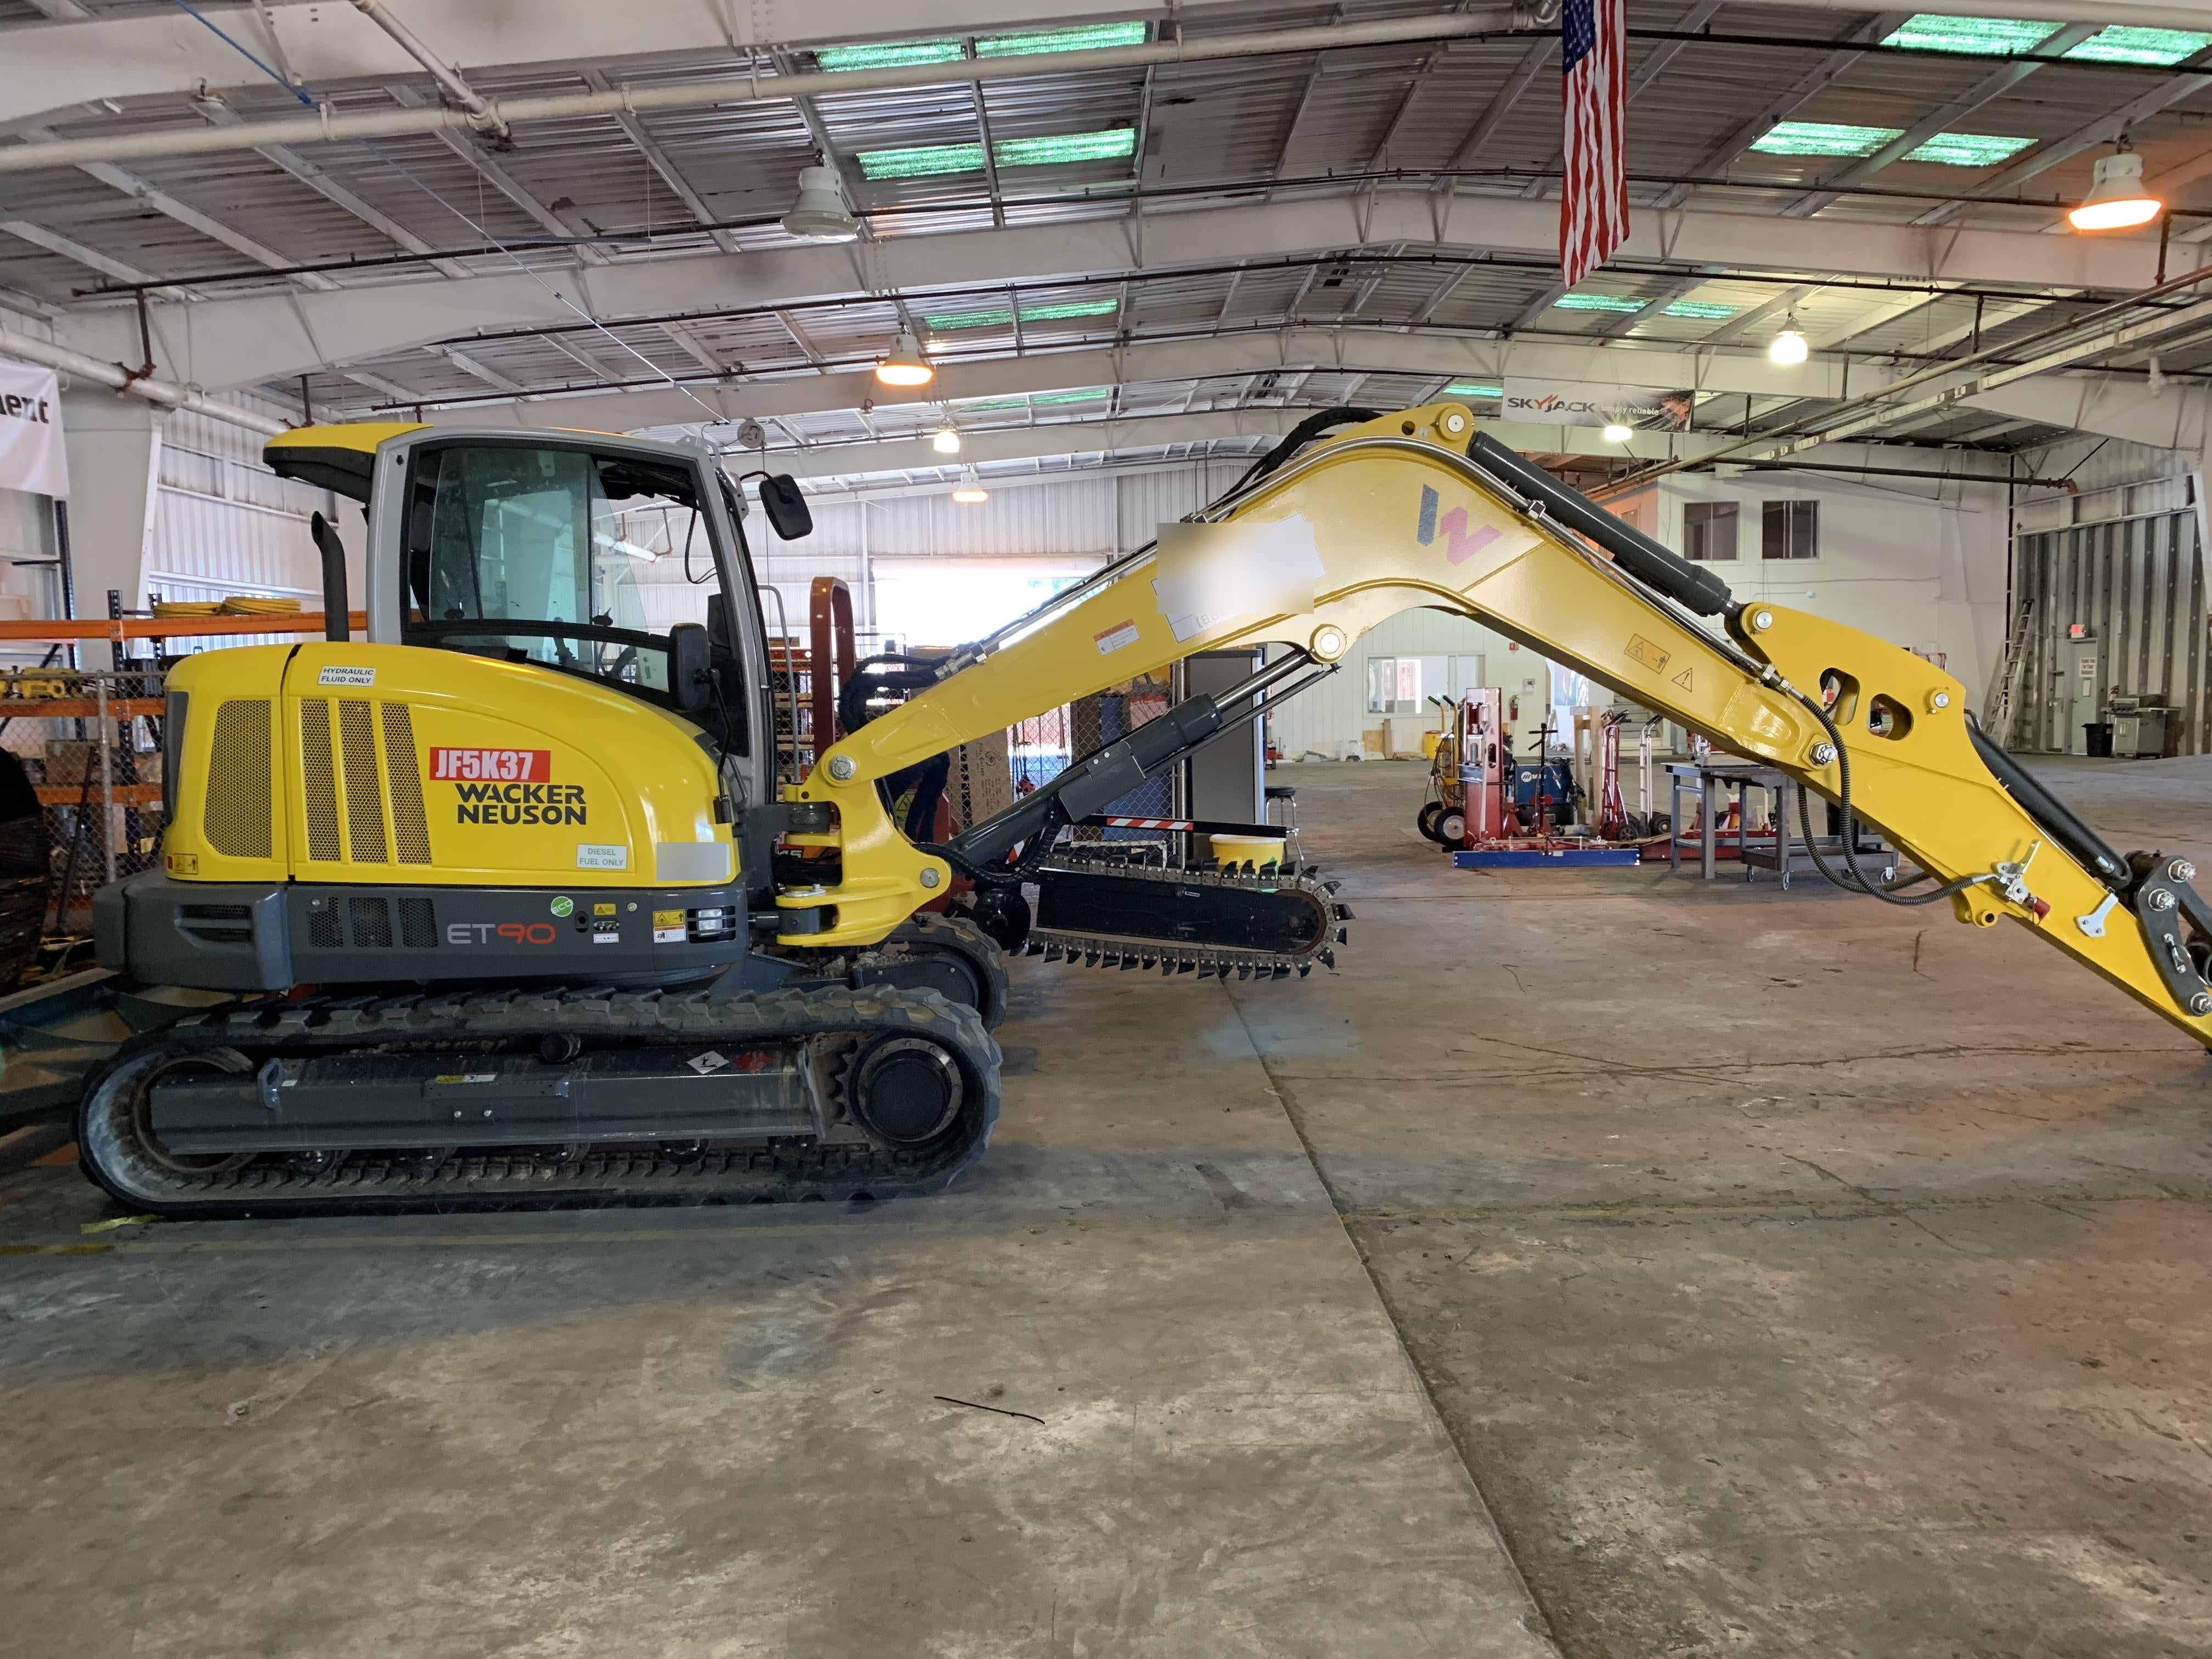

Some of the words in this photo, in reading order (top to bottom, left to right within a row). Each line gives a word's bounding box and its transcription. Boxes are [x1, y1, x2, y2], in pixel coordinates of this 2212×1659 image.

[1508, 394, 1596, 413] SKYJACK
[1601, 405, 1628, 414] simply
[1629, 407, 1659, 415] reliable
[436, 749, 533, 780] JF5K37
[454, 783, 586, 804] WACKER
[458, 804, 586, 825] NEUSON
[588, 848, 617, 856] DIESEL
[551, 900, 573, 914] ECO
[447, 923, 556, 944] ET90
